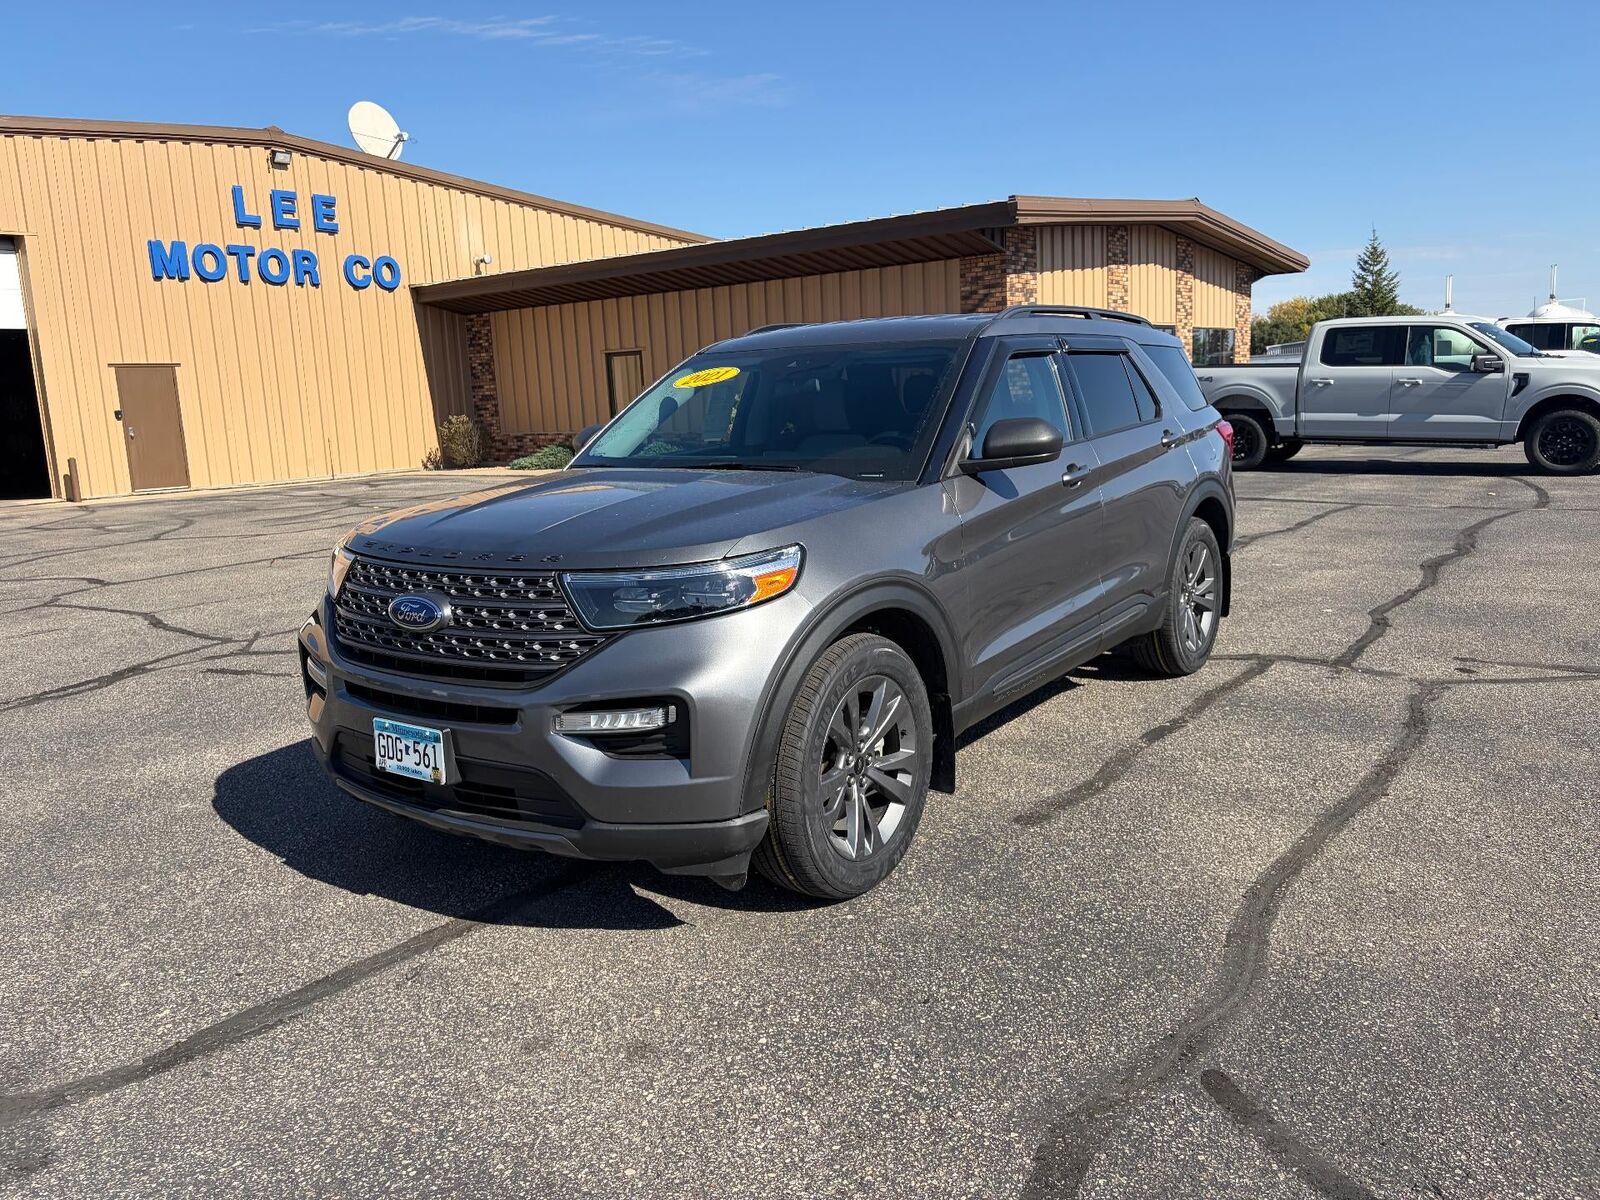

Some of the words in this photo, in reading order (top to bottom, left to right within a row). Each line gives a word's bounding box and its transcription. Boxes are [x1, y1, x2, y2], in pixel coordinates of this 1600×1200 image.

[232, 185, 339, 233] LEE
[148, 239, 320, 287] MOTOR
[343, 254, 401, 292] CO
[681, 369, 732, 386] 2021
[397, 602, 427, 623] Ford
[377, 733, 403, 762] GDG
[413, 741, 439, 770] 561
